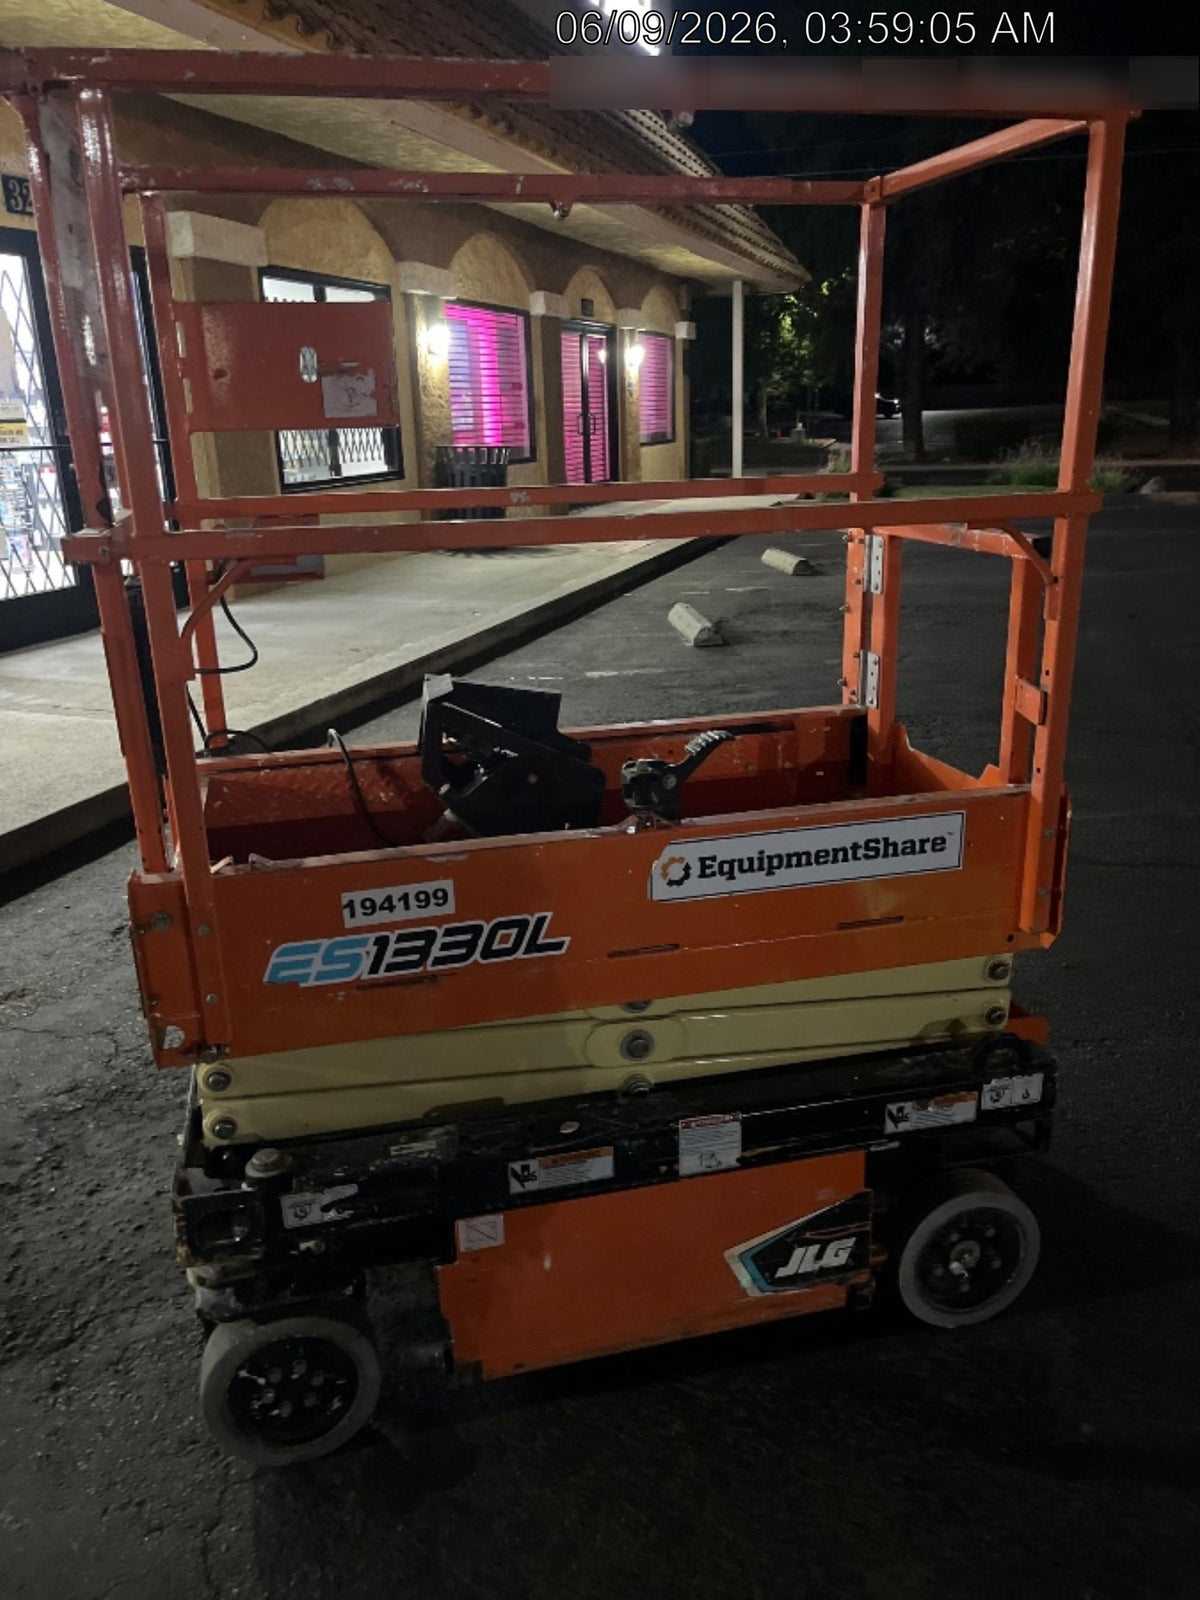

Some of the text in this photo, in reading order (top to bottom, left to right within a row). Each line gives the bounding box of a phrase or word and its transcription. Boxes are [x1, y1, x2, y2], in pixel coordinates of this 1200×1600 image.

[698, 835, 948, 881] EquipmentShare
[342, 887, 449, 919] 194199
[264, 913, 570, 986] ES1330L
[774, 1236, 857, 1279] JLG
